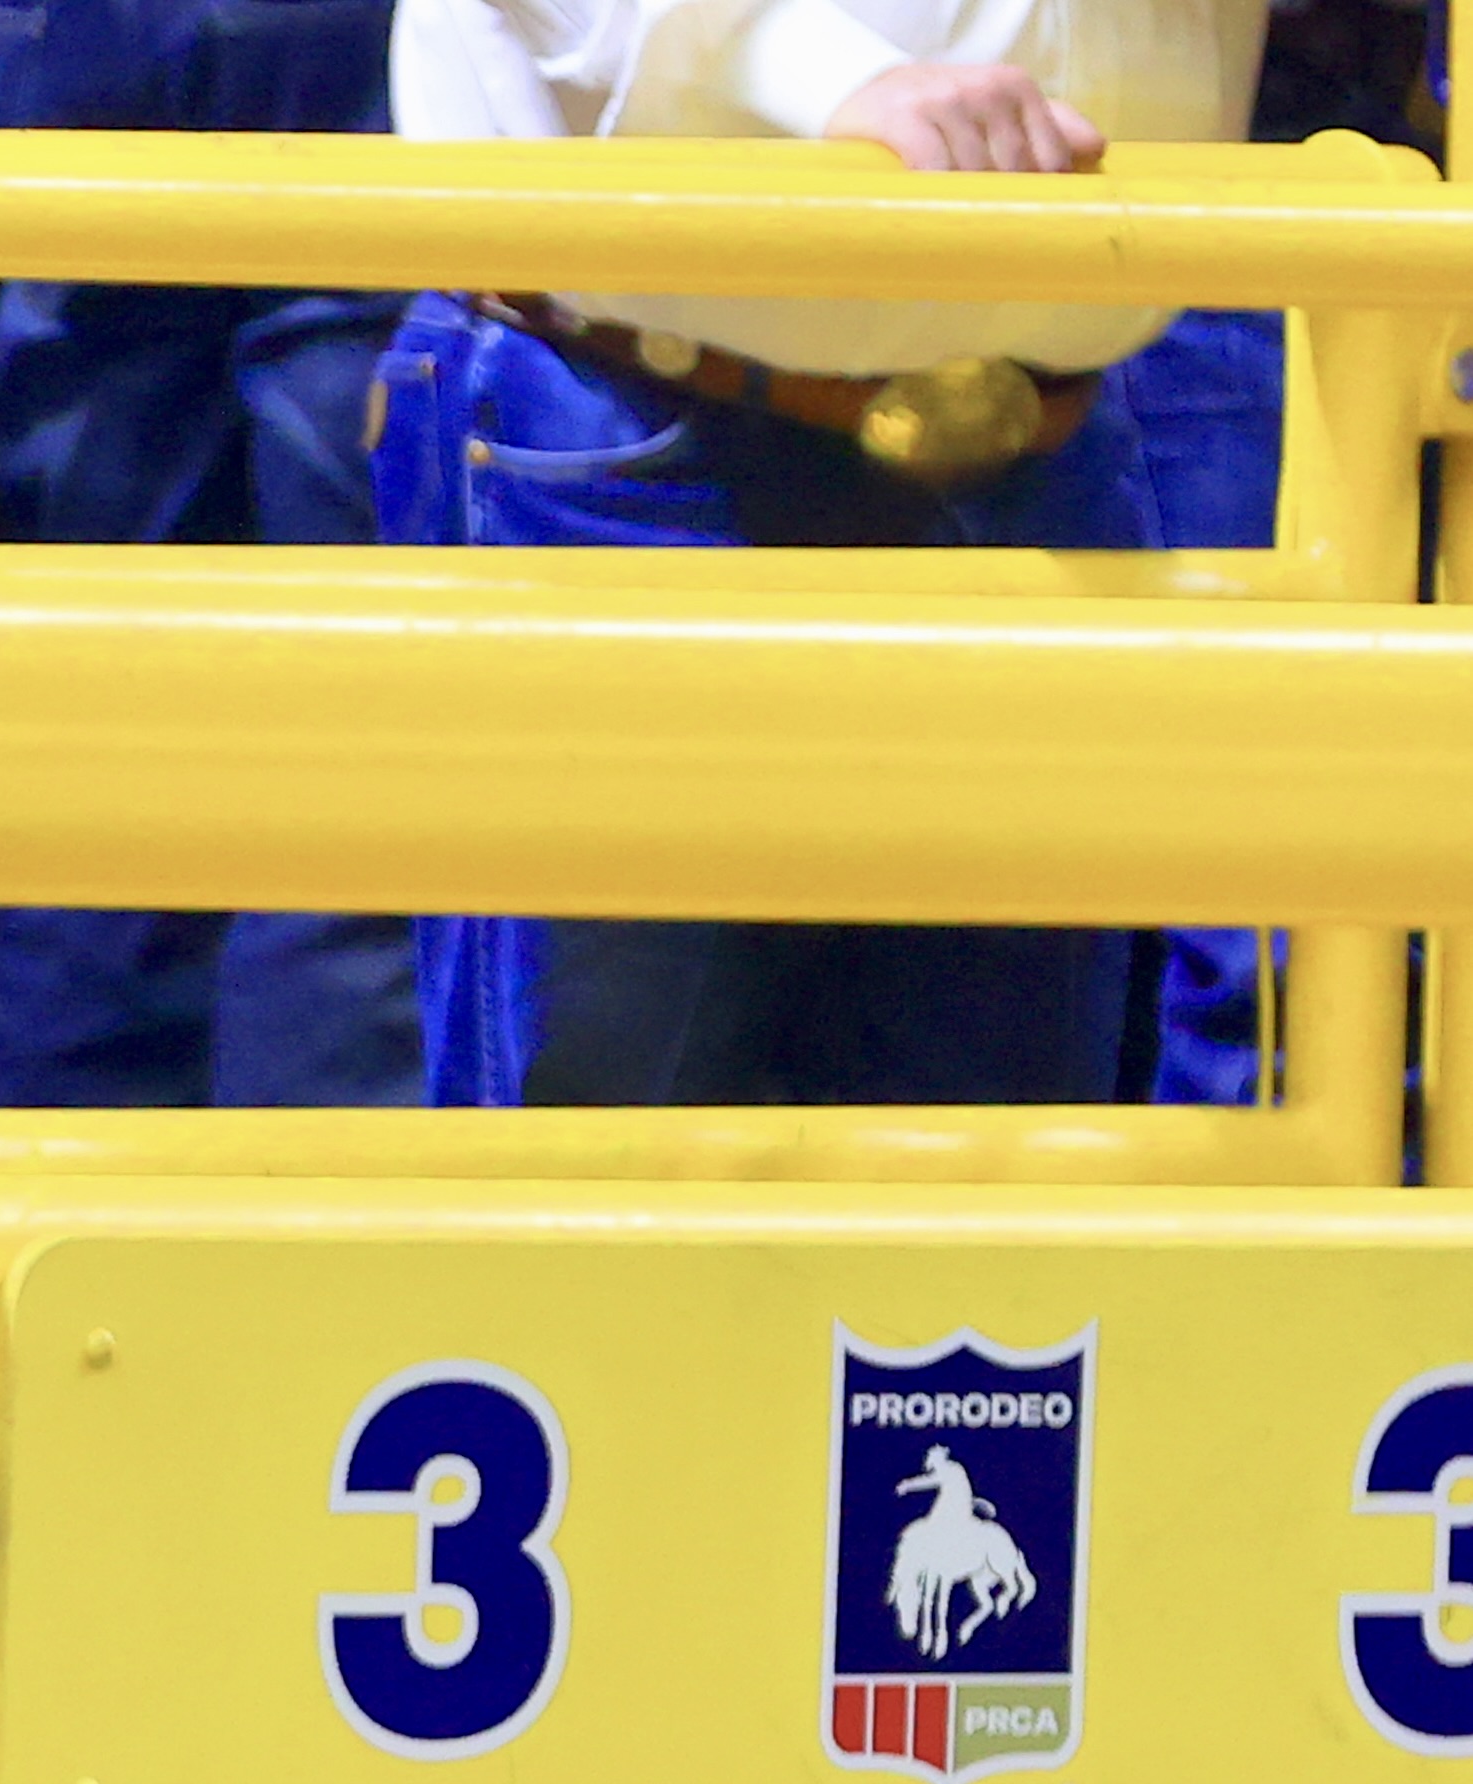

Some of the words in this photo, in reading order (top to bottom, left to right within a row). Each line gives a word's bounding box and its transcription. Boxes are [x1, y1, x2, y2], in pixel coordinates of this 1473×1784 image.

[851, 1392, 1073, 1429] PRORODEO
[328, 1374, 560, 1746] 3
[964, 1705, 1059, 1737] PRCA
